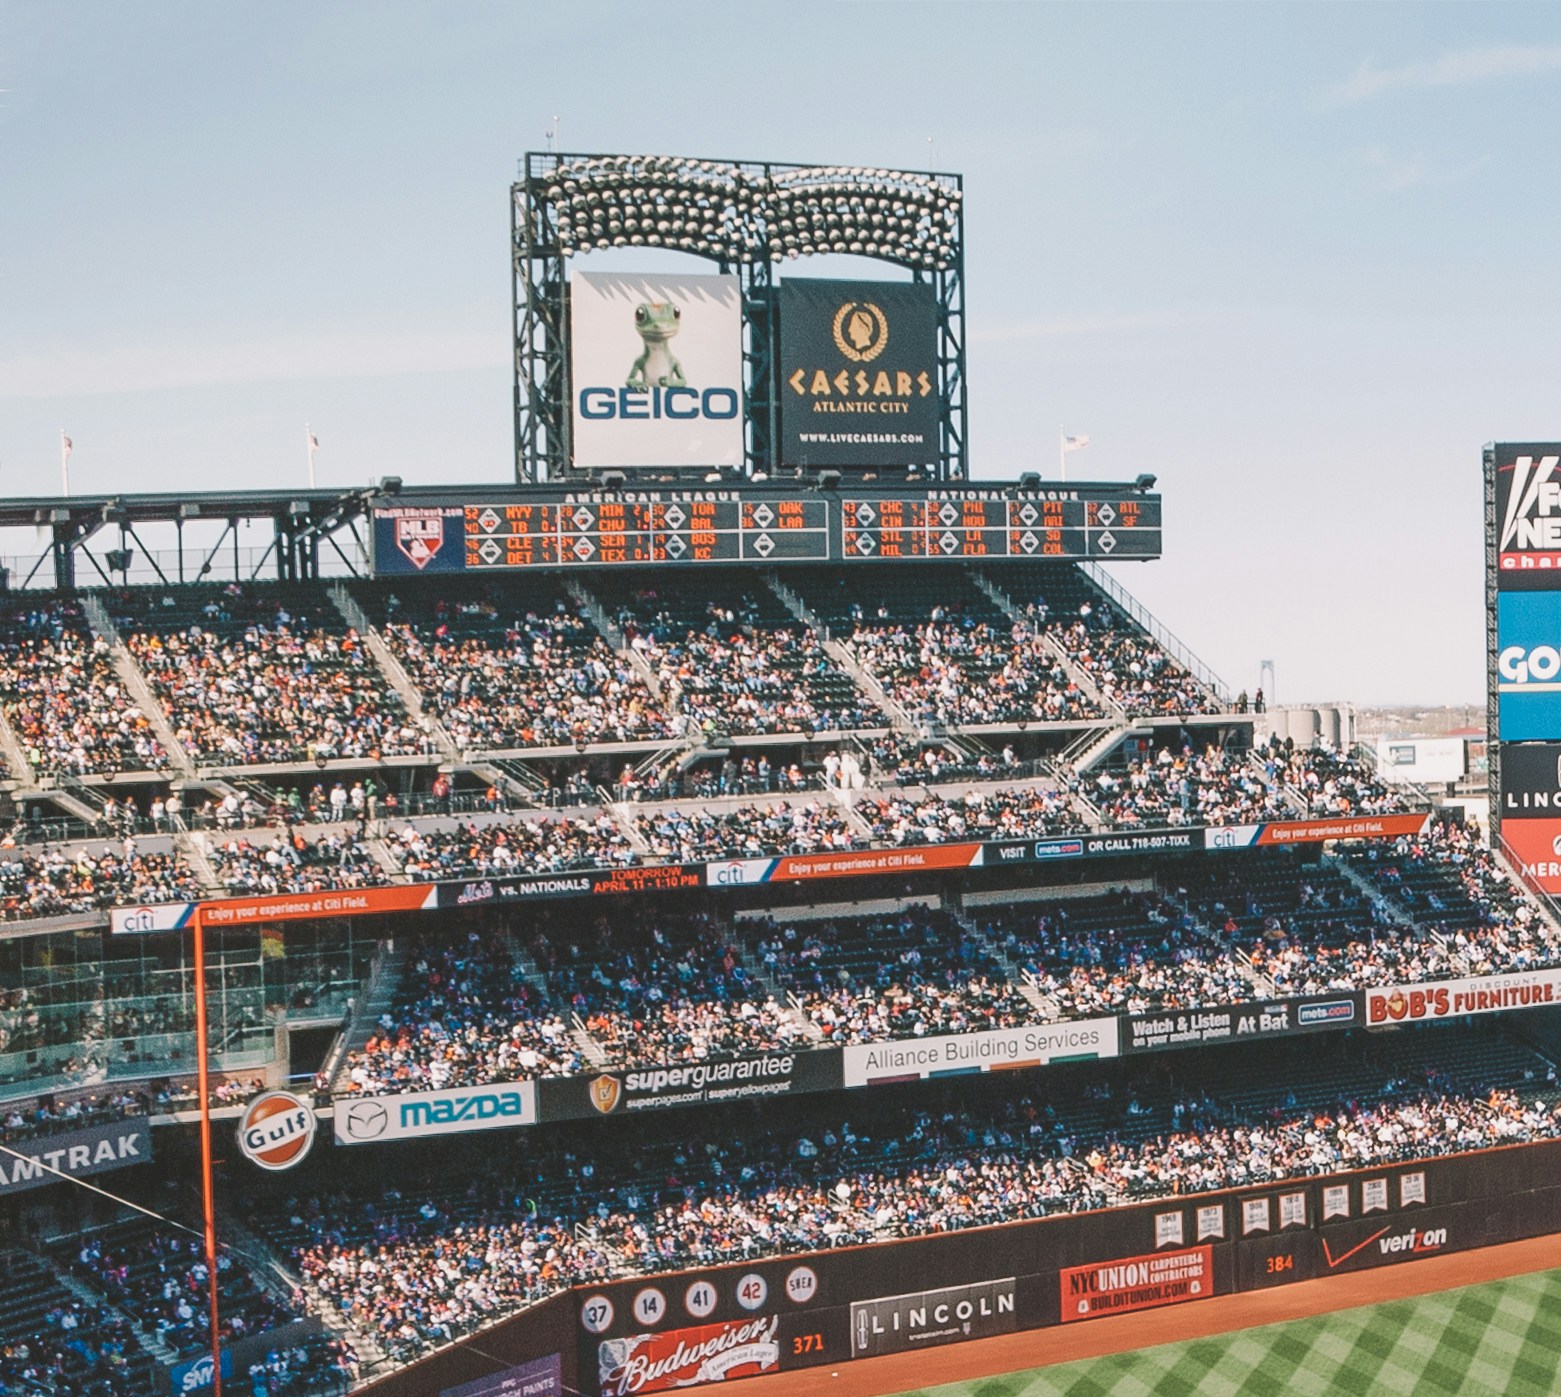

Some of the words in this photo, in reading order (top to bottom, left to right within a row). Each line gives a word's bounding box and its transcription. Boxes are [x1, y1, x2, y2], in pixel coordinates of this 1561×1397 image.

[788, 369, 932, 398] CAESARS
[579, 386, 739, 420] GEICO
[813, 401, 877, 413] ATLANTIC
[879, 402, 909, 413] CITY
[799, 433, 924, 443] WWW.LIVECAESARS.COM
[564, 491, 662, 504] AMERICAN
[671, 491, 741, 502] LEAGUE
[927, 490, 1009, 500] NATIONAL
[1017, 490, 1079, 500] LEAGUE
[506, 506, 532, 518] NYY
[510, 521, 528, 533] TB
[506, 537, 532, 549] CLE
[610, 866, 683, 880] TOMORROW
[520, 878, 590, 895] NATIONALS
[123, 912, 155, 931] citi
[1369, 988, 1448, 1022] BOB'S
[1454, 985, 1554, 1013] FURNITURE
[1132, 1018, 1174, 1037] Watch
[1188, 1012, 1231, 1030] Listen
[1236, 1016, 1257, 1035] At
[1260, 1012, 1290, 1032] Bat
[865, 1043, 939, 1071] Alliance
[945, 1034, 1021, 1067] Building
[1024, 1027, 1101, 1057] Services
[624, 1054, 795, 1092] superguarantee
[244, 1110, 307, 1151] Gulf
[1379, 1228, 1447, 1256] verizon
[1266, 1255, 1294, 1273] 384
[741, 1282, 761, 1300] 42
[789, 1275, 812, 1291] SHEA
[642, 1297, 658, 1315] 14
[692, 1290, 708, 1307] 41
[588, 1305, 607, 1324] 37
[871, 1293, 1015, 1335] LINCOLN
[793, 1333, 824, 1354] 371
[604, 1316, 767, 1396] Budweiser
[522, 1377, 555, 1397] PAINTS
